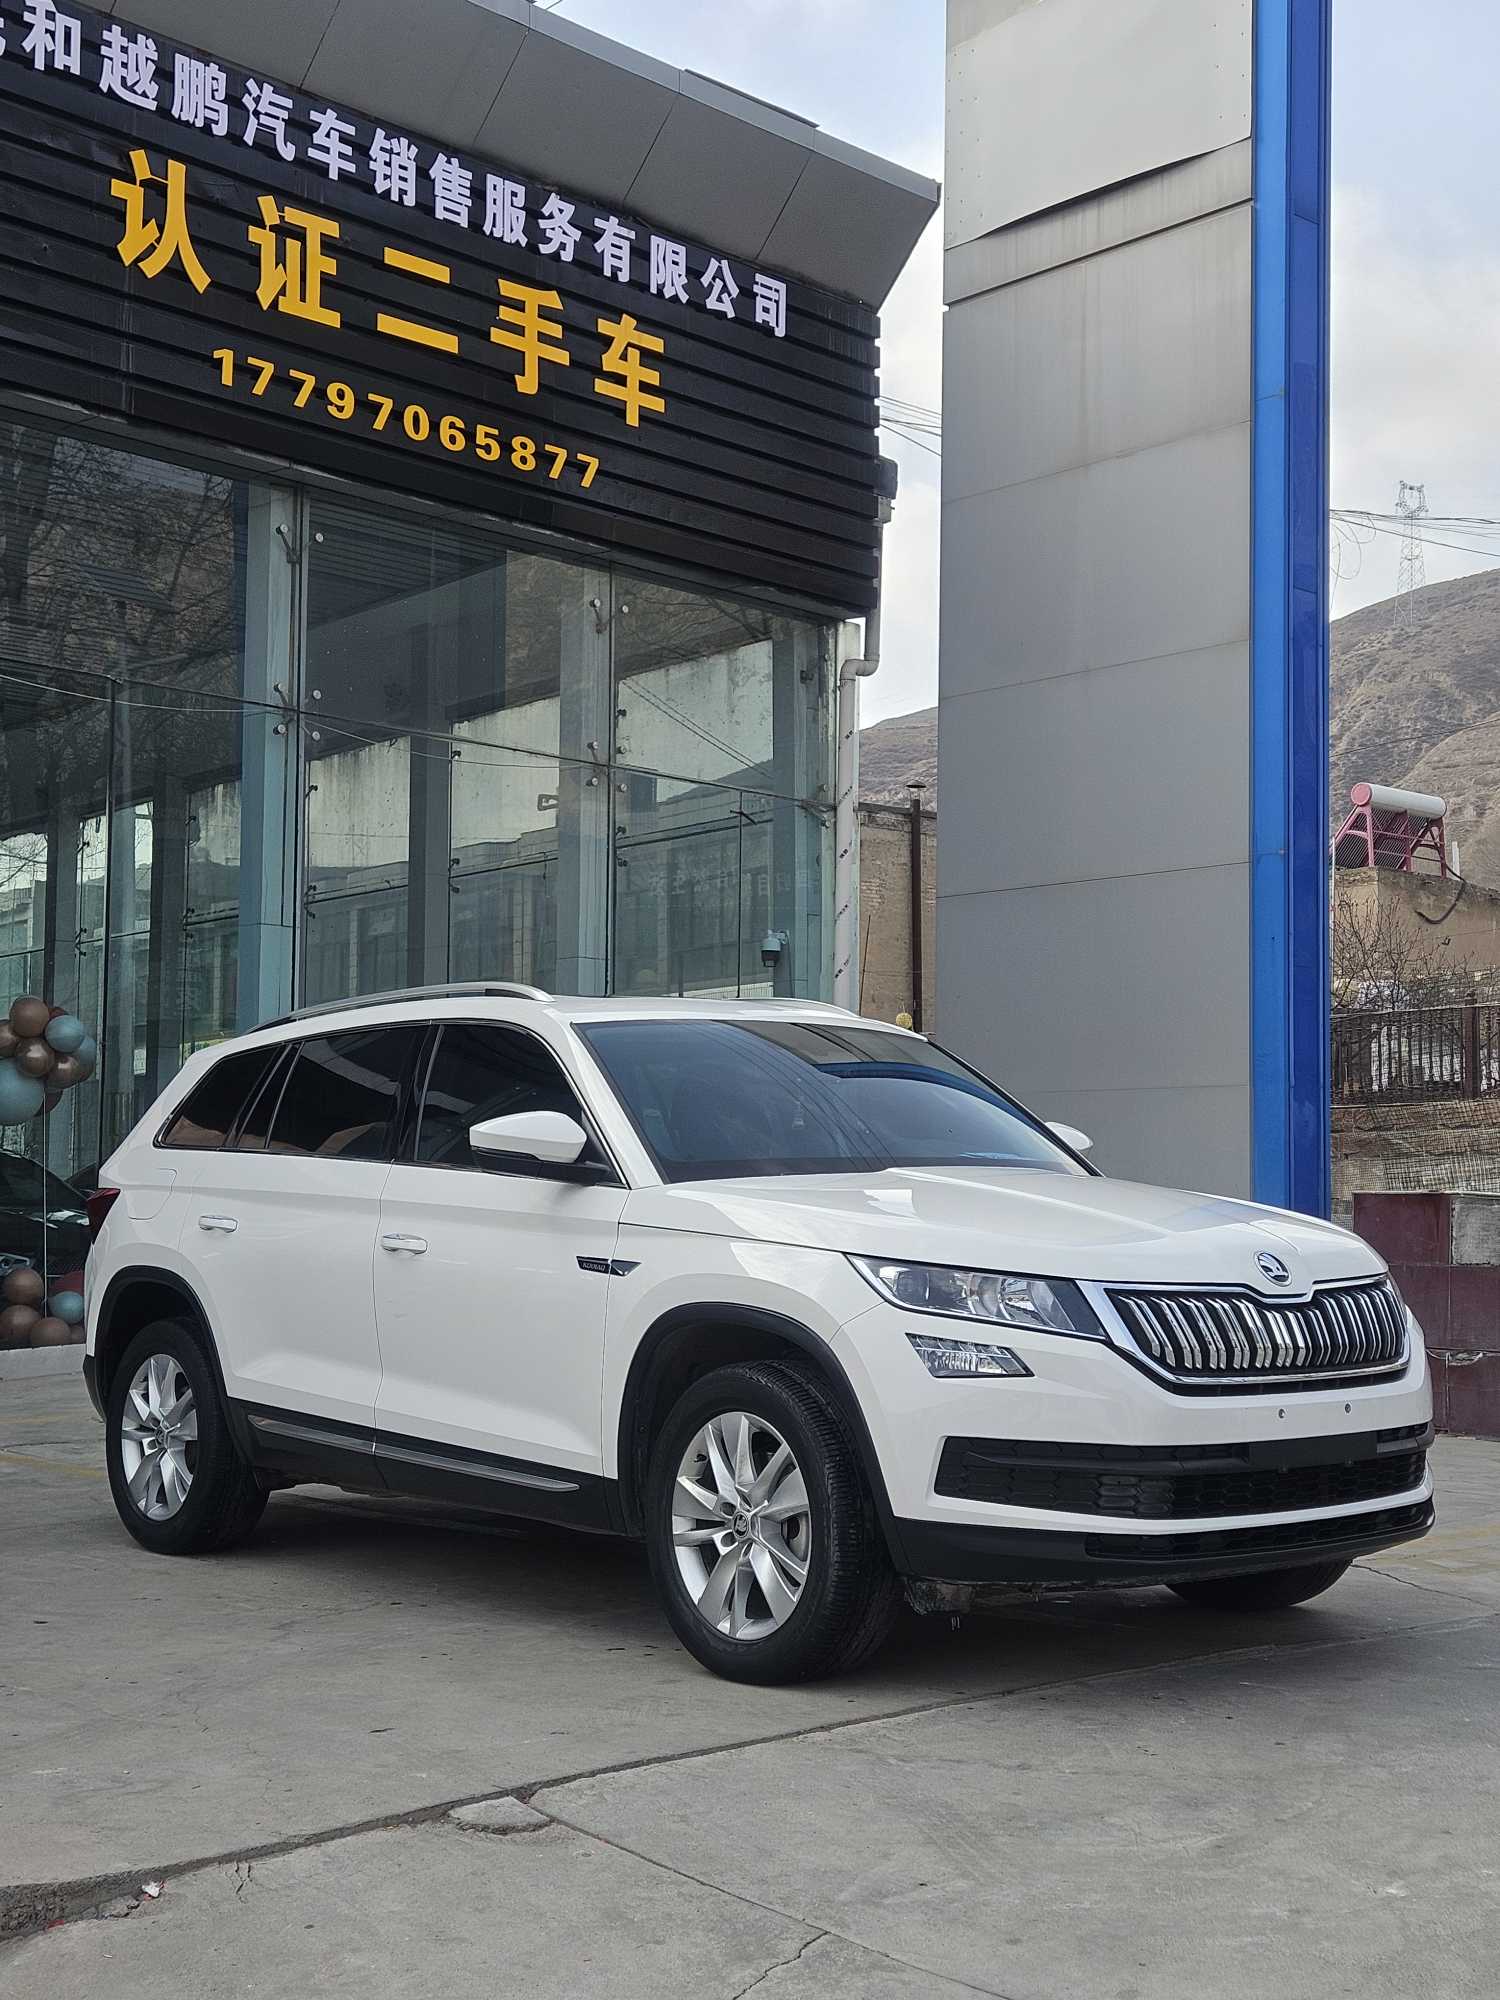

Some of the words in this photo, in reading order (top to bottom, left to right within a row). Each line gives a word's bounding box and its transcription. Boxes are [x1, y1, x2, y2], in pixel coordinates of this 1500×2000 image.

[0, 0, 788, 338] 和越鹏汽车销售服务有限公司
[110, 149, 667, 428] 认证二手车
[211, 347, 600, 489] 17797065877
